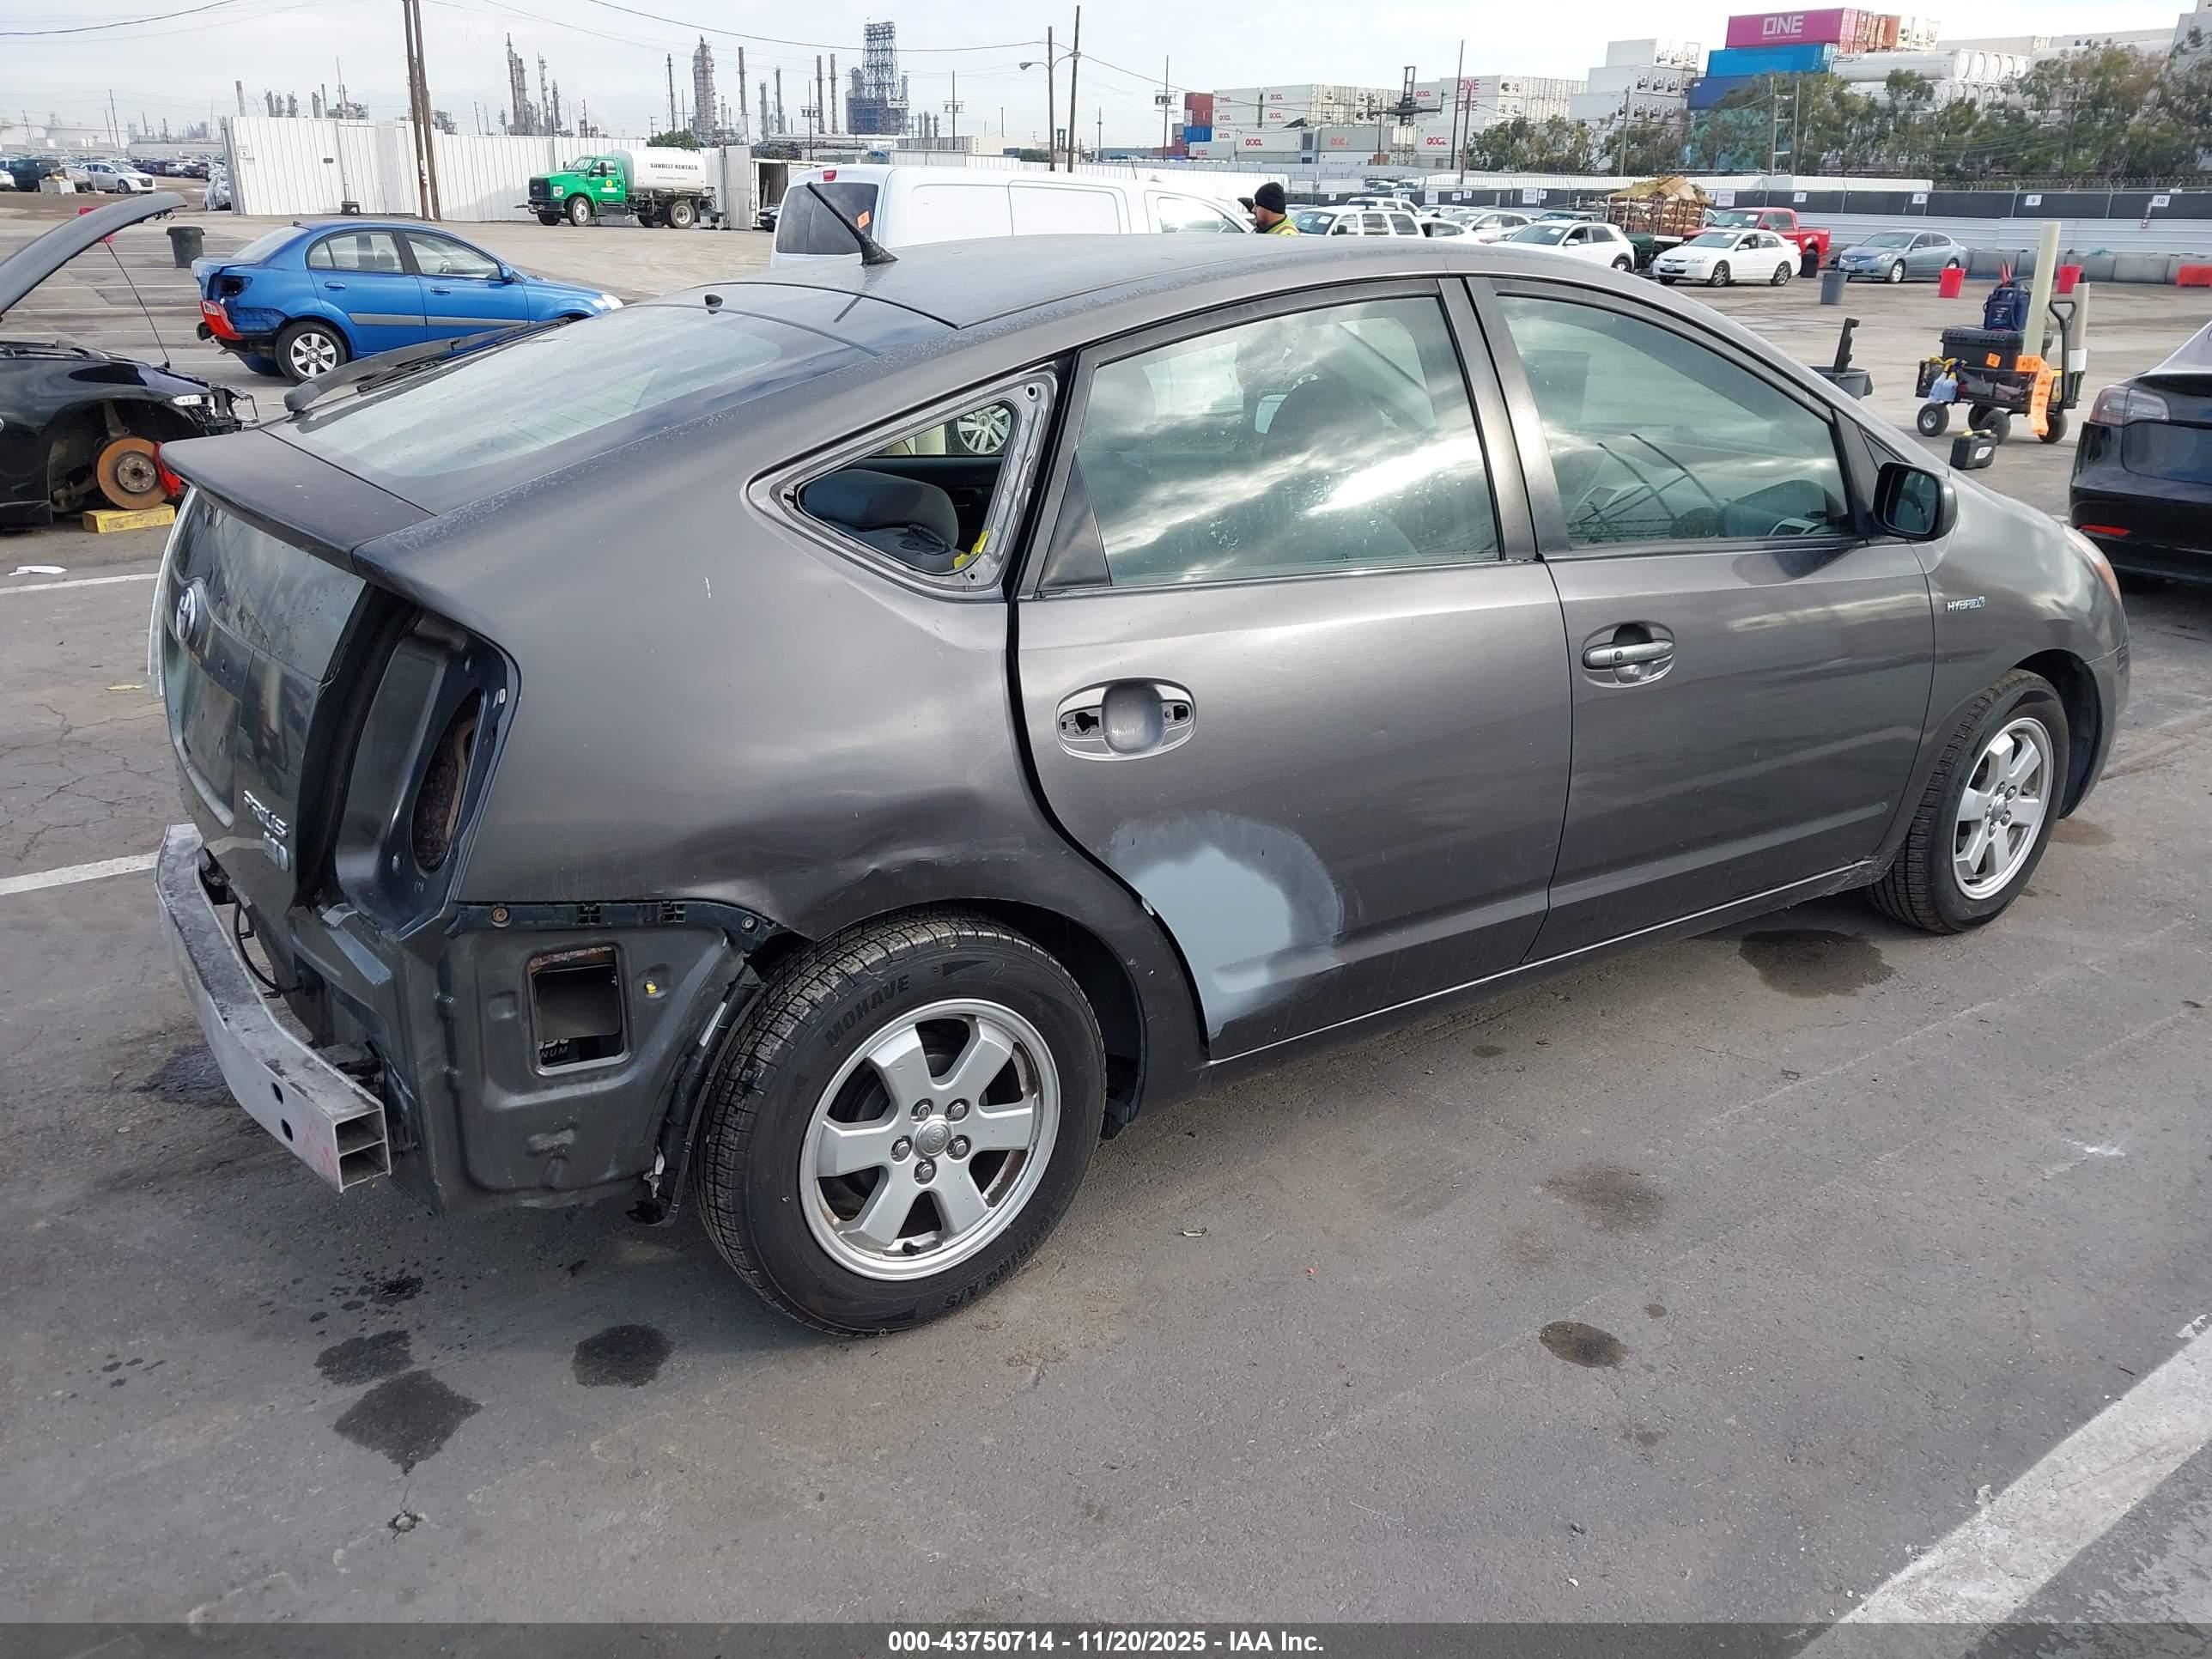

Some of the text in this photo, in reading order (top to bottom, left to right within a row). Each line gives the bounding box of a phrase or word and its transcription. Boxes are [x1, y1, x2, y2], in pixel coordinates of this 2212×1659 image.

[1762, 15, 1804, 35] ONE
[1245, 137, 1262, 146] OOCL
[1947, 599, 1978, 611] HYBRID
[244, 790, 288, 838] PRIUS
[824, 974, 909, 1046] MOHAVE
